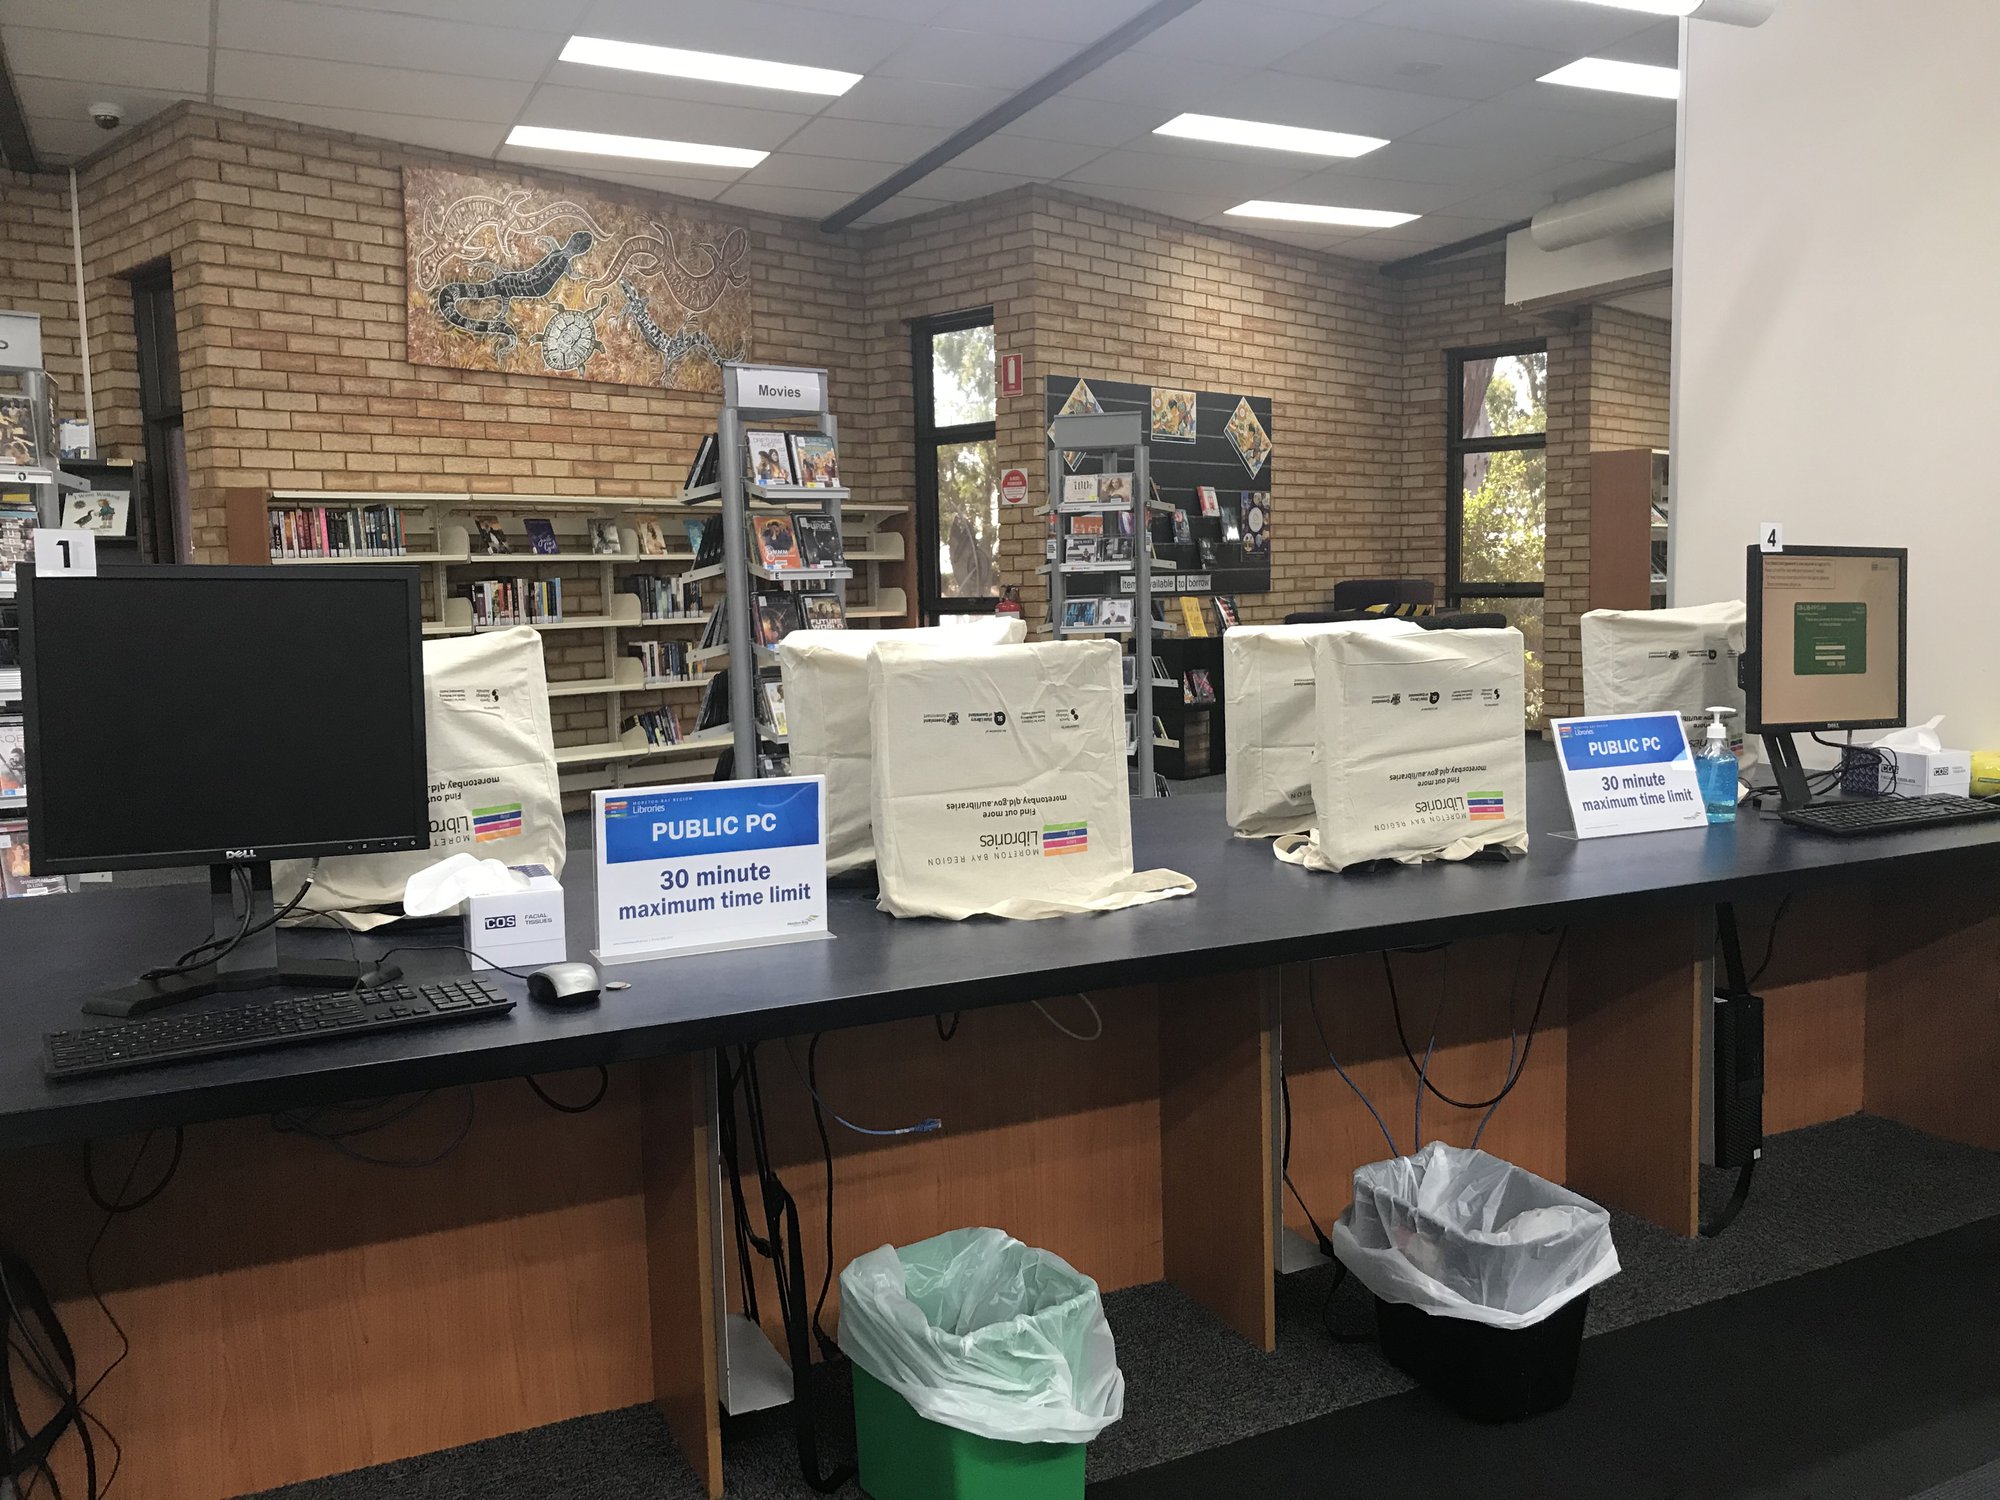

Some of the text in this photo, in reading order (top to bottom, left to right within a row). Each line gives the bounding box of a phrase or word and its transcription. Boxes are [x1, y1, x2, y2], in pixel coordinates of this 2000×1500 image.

[759, 385, 801, 398] Movies
[1767, 529, 1776, 547] 4
[56, 540, 71, 568] 1
[1178, 580, 1185, 588] to
[1188, 578, 1209, 588] borrow
[1588, 737, 1661, 756] PUBLIC PC
[1934, 767, 1948, 776] COS
[1601, 772, 1666, 791] 30 minute
[445, 792, 461, 802] Find
[946, 794, 1067, 811] moretonbay.qld.gov.au/libraries
[1415, 797, 1465, 814] Libraries
[1582, 788, 1694, 811] maximum time limit
[632, 804, 665, 814] Libraries
[982, 810, 1003, 818] more
[1019, 808, 1036, 817] Find
[429, 816, 469, 834] Libra
[652, 812, 776, 842] PUBLIC PC
[1374, 812, 1467, 831] MORETON BAY REGION
[433, 835, 470, 847] MORET
[980, 830, 1038, 850] Libraries
[226, 849, 256, 859] DELL
[927, 849, 1039, 866] MORETON BAY REGION
[660, 863, 770, 891] 30 minute
[619, 883, 811, 920] maximum time limit
[486, 916, 515, 929] COS
